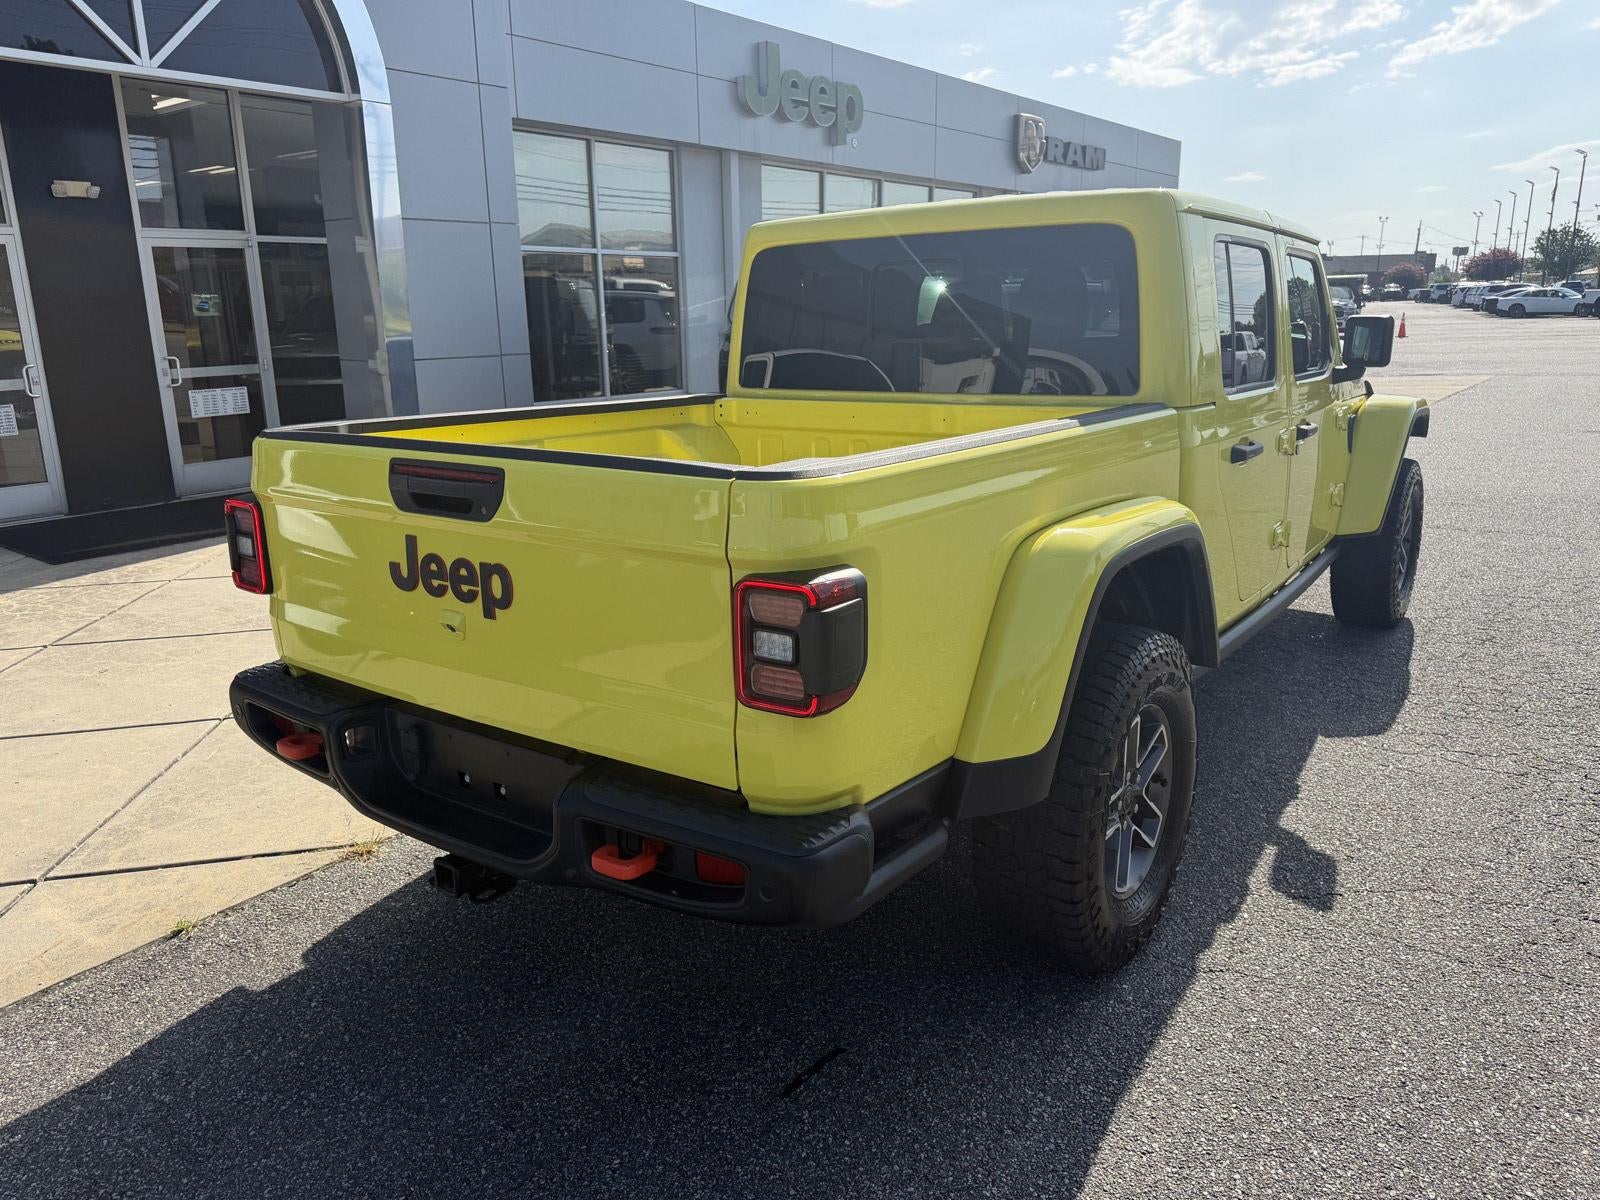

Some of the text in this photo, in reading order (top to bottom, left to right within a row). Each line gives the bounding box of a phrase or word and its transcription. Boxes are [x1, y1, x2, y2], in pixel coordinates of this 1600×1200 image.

[736, 40, 864, 146] Jeep
[1045, 136, 1106, 171] RAM
[388, 533, 514, 621] Jeep
